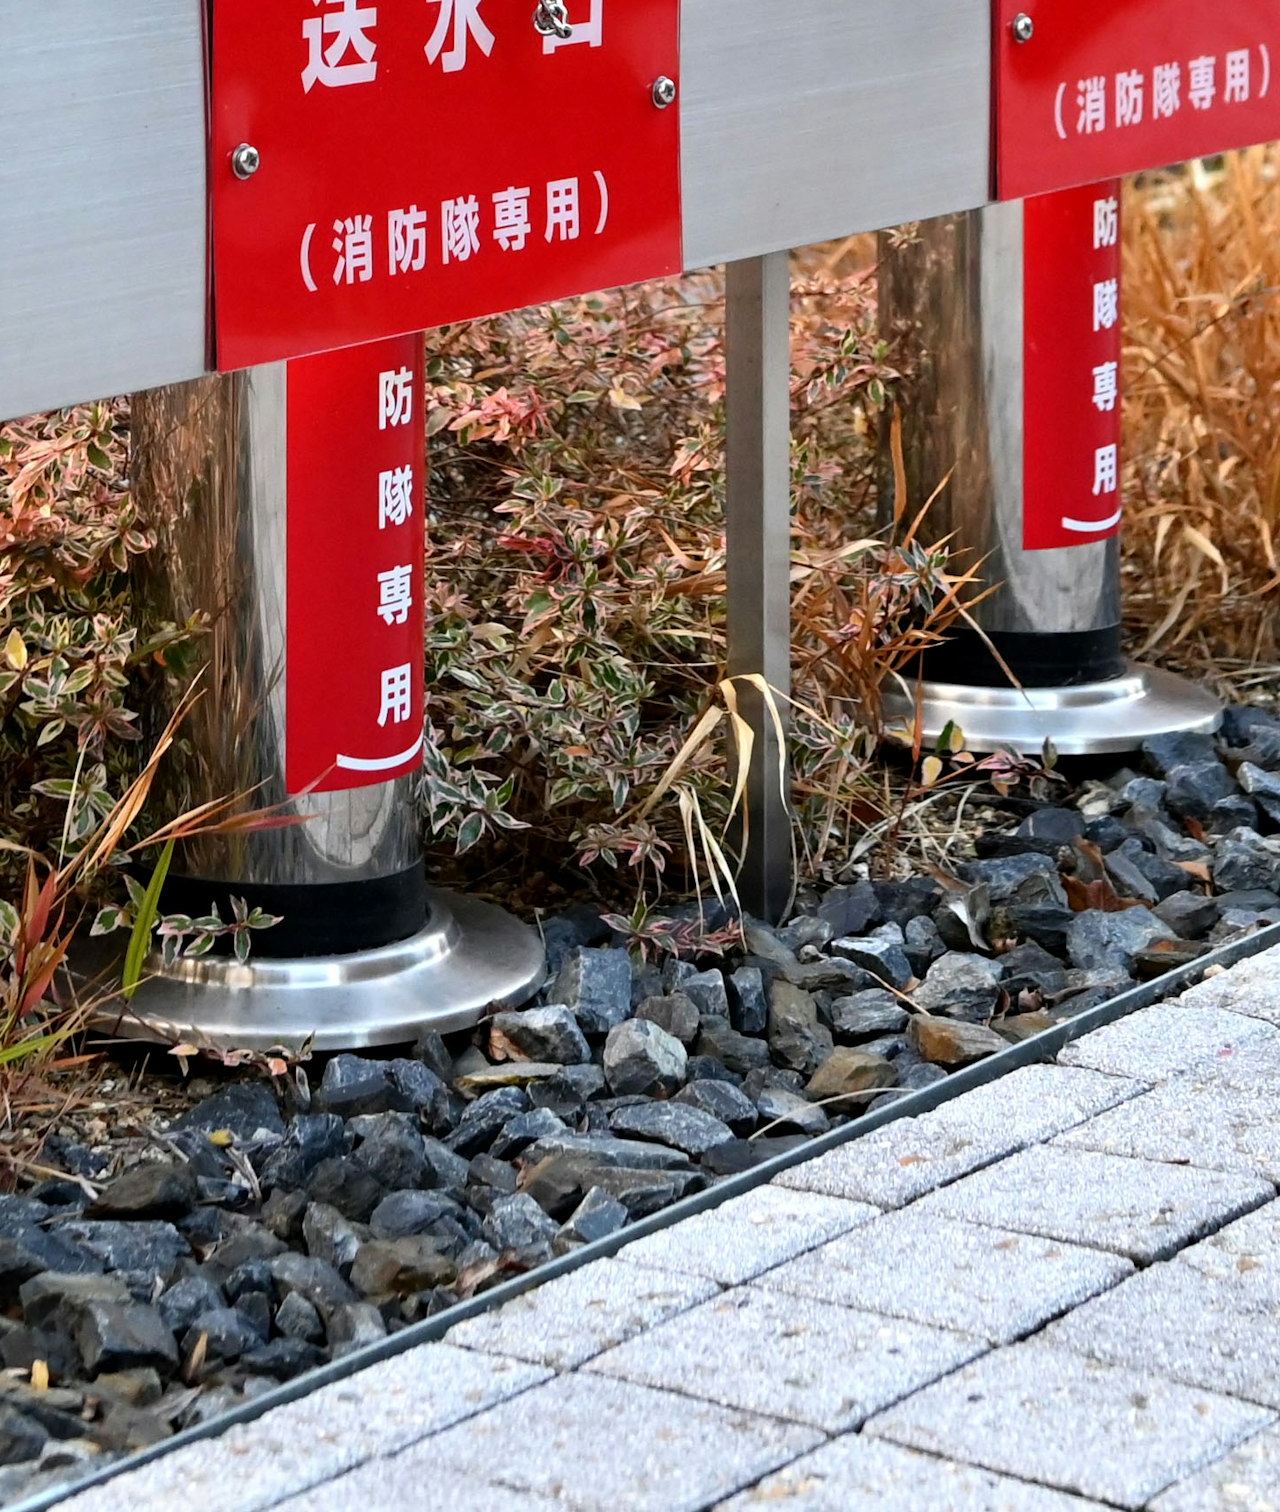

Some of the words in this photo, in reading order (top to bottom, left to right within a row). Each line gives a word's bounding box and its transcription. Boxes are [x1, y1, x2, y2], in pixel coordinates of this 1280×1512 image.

[1053, 44, 1270, 139] （消防隊専用）
[300, 170, 609, 292] （消防隊専用）
